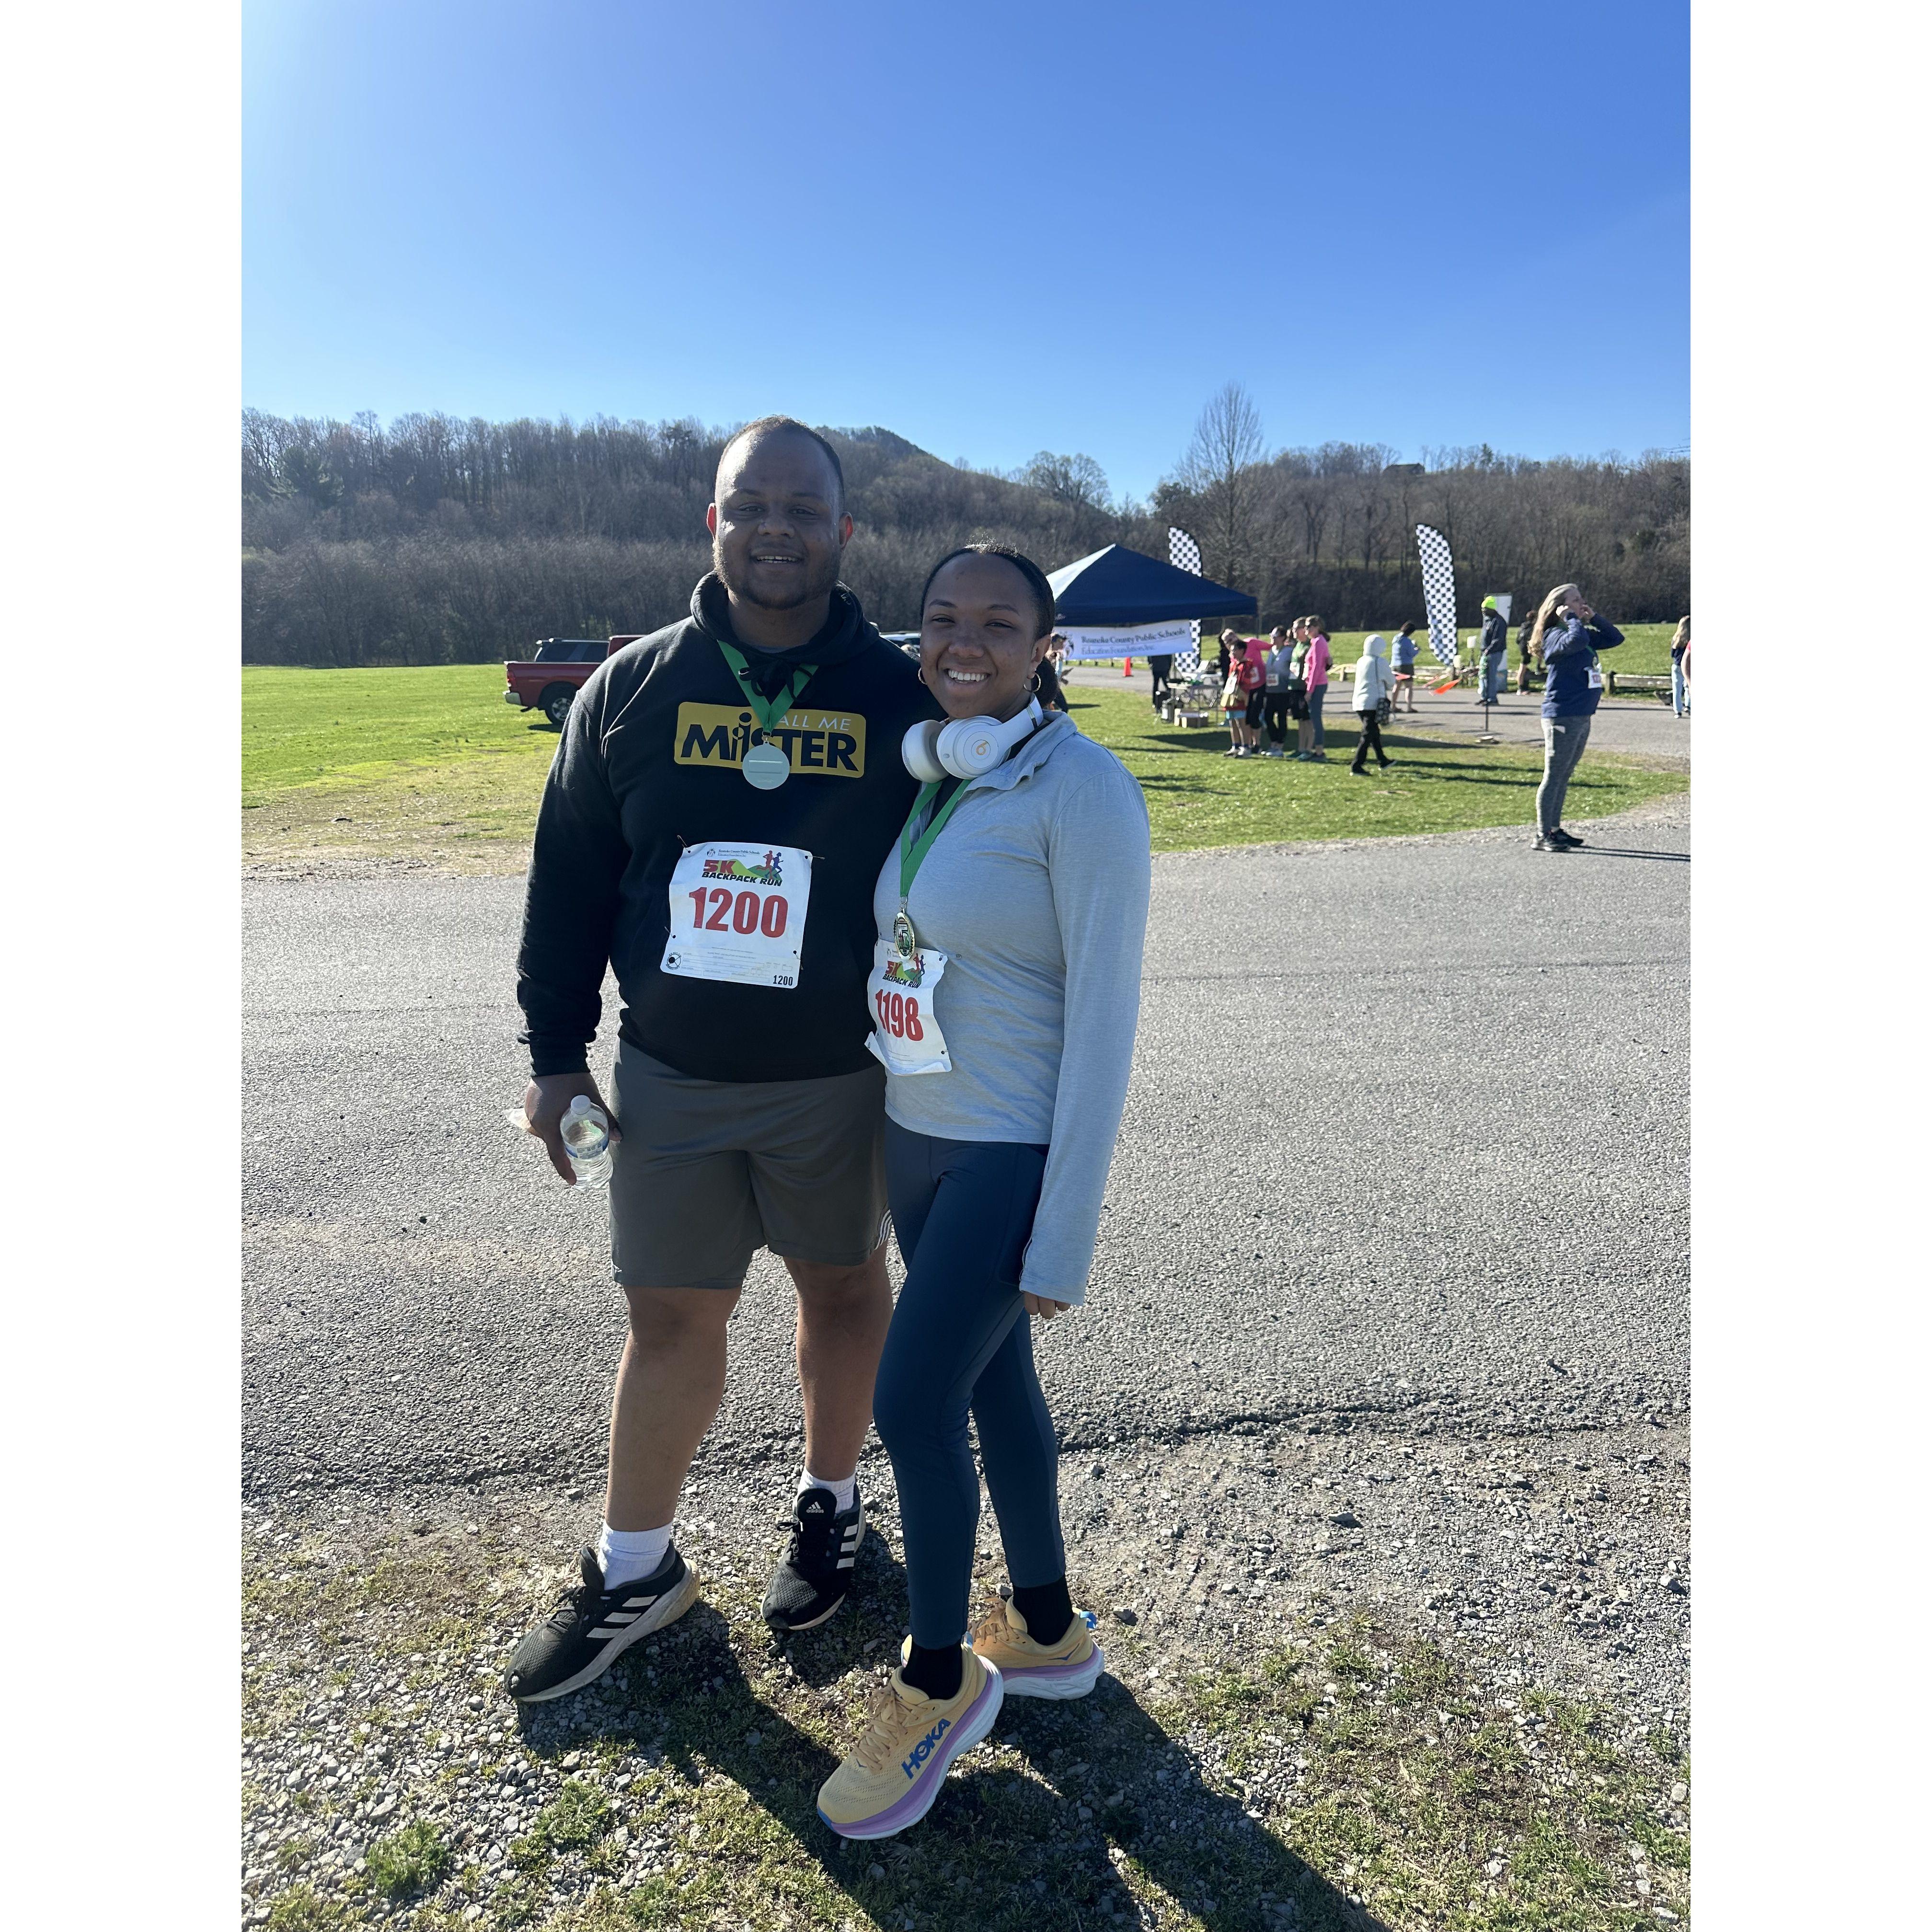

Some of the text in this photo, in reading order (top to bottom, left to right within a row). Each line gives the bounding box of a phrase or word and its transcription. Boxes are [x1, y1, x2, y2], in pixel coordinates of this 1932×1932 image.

[1110, 636, 1134, 644] County
[1135, 632, 1157, 642] Public
[1158, 628, 1185, 638] Schools
[778, 714, 851, 731] ALL ME
[703, 860, 736, 874] 5K
[702, 872, 782, 886] BACKPACK RUN
[689, 887, 788, 938] 1200
[773, 975, 793, 986] 1200
[882, 974, 921, 989] BACKPACK RUN
[875, 989, 923, 1041] 1198
[901, 1718, 951, 1779] HOKA
